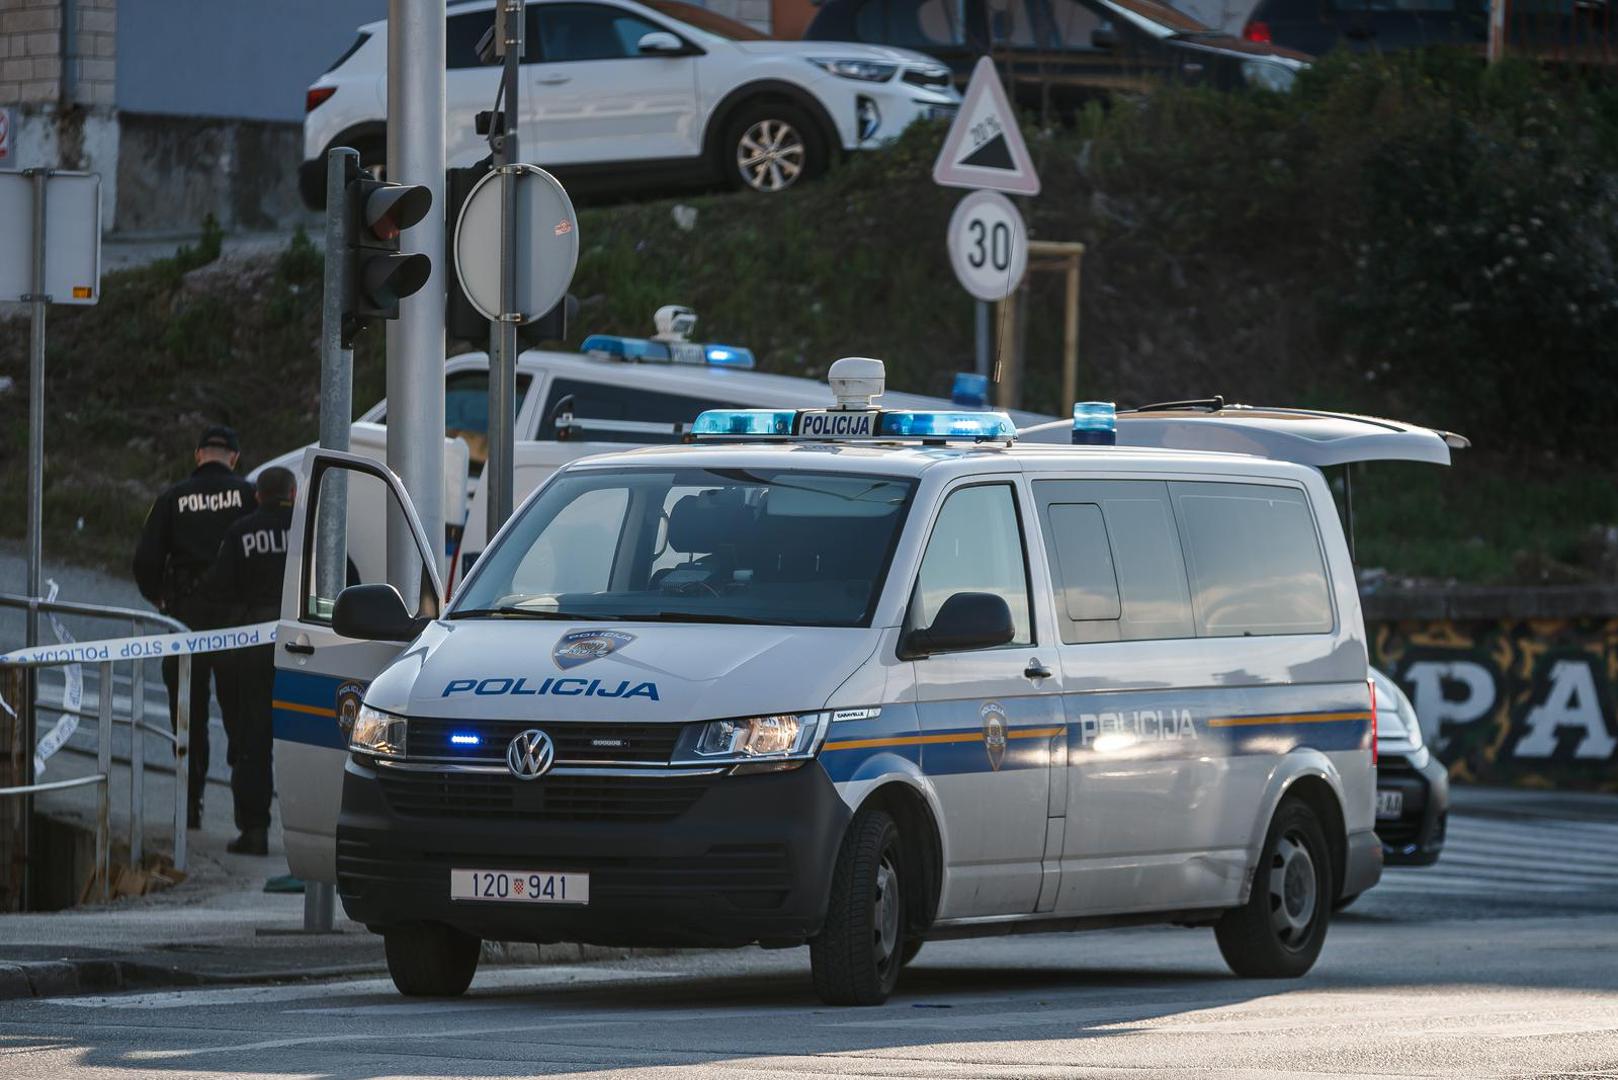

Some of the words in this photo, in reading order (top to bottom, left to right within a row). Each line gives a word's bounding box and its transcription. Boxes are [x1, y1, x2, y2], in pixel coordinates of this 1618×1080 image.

[968, 218, 1010, 271] 30
[803, 416, 869, 435] POLICIJA
[178, 490, 242, 513] POLICIJA
[242, 529, 290, 558] POLI
[186, 630, 259, 652] POLICIJA
[568, 632, 632, 641] POLICIJA
[121, 641, 162, 657] STOP
[442, 678, 659, 700] POLICIJA
[1080, 709, 1198, 746] POLICIJA
[473, 873, 508, 898] 120
[528, 875, 566, 900] 941
